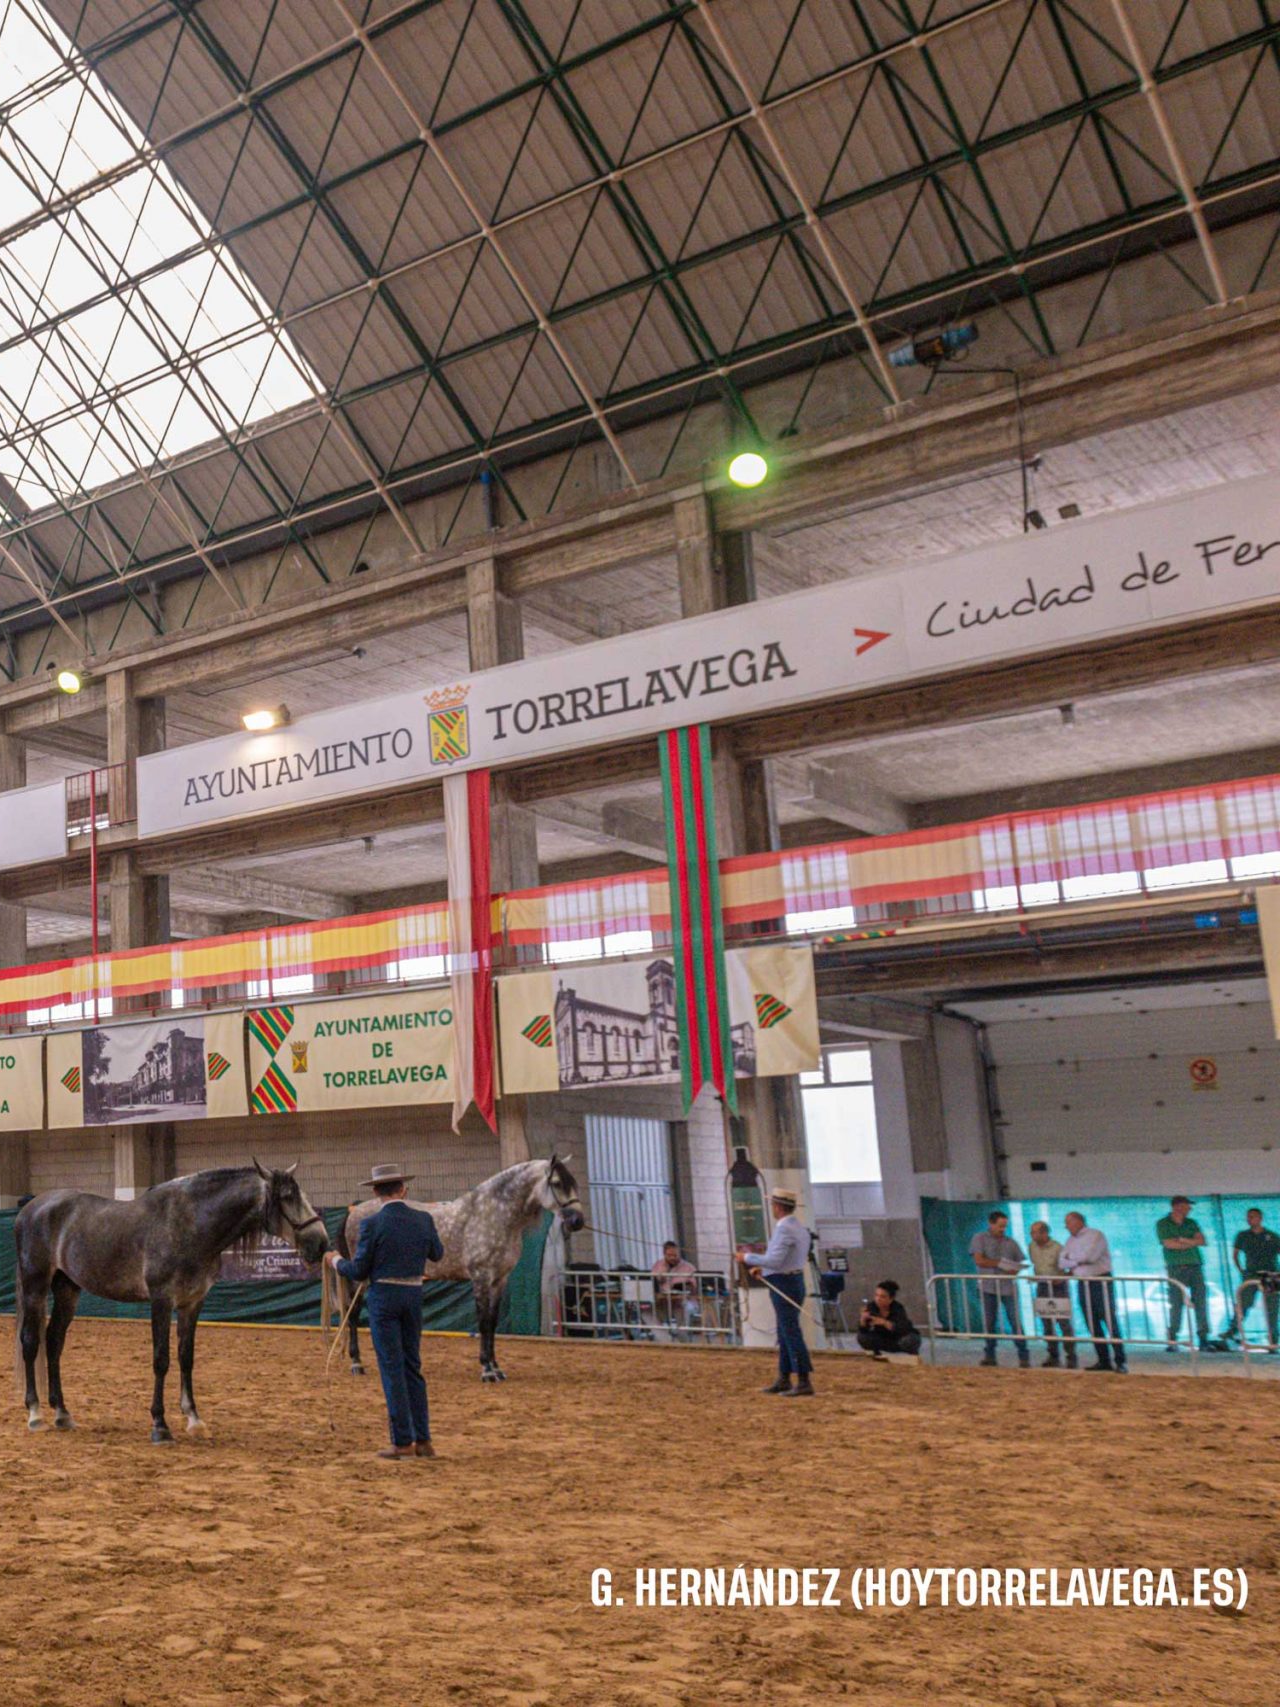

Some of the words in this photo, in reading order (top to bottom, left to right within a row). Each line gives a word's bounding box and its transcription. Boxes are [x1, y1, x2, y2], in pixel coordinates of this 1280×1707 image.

[926, 564, 1095, 637] Ciudad
[1120, 552, 1180, 591] de
[183, 727, 413, 806] AYUNTAMIENTO
[486, 641, 798, 740] TORRELAVEGA
[313, 1008, 453, 1038] AYUNTAMIENTO
[372, 1042, 393, 1058] DE
[323, 1064, 448, 1088] TORRELAVEGA
